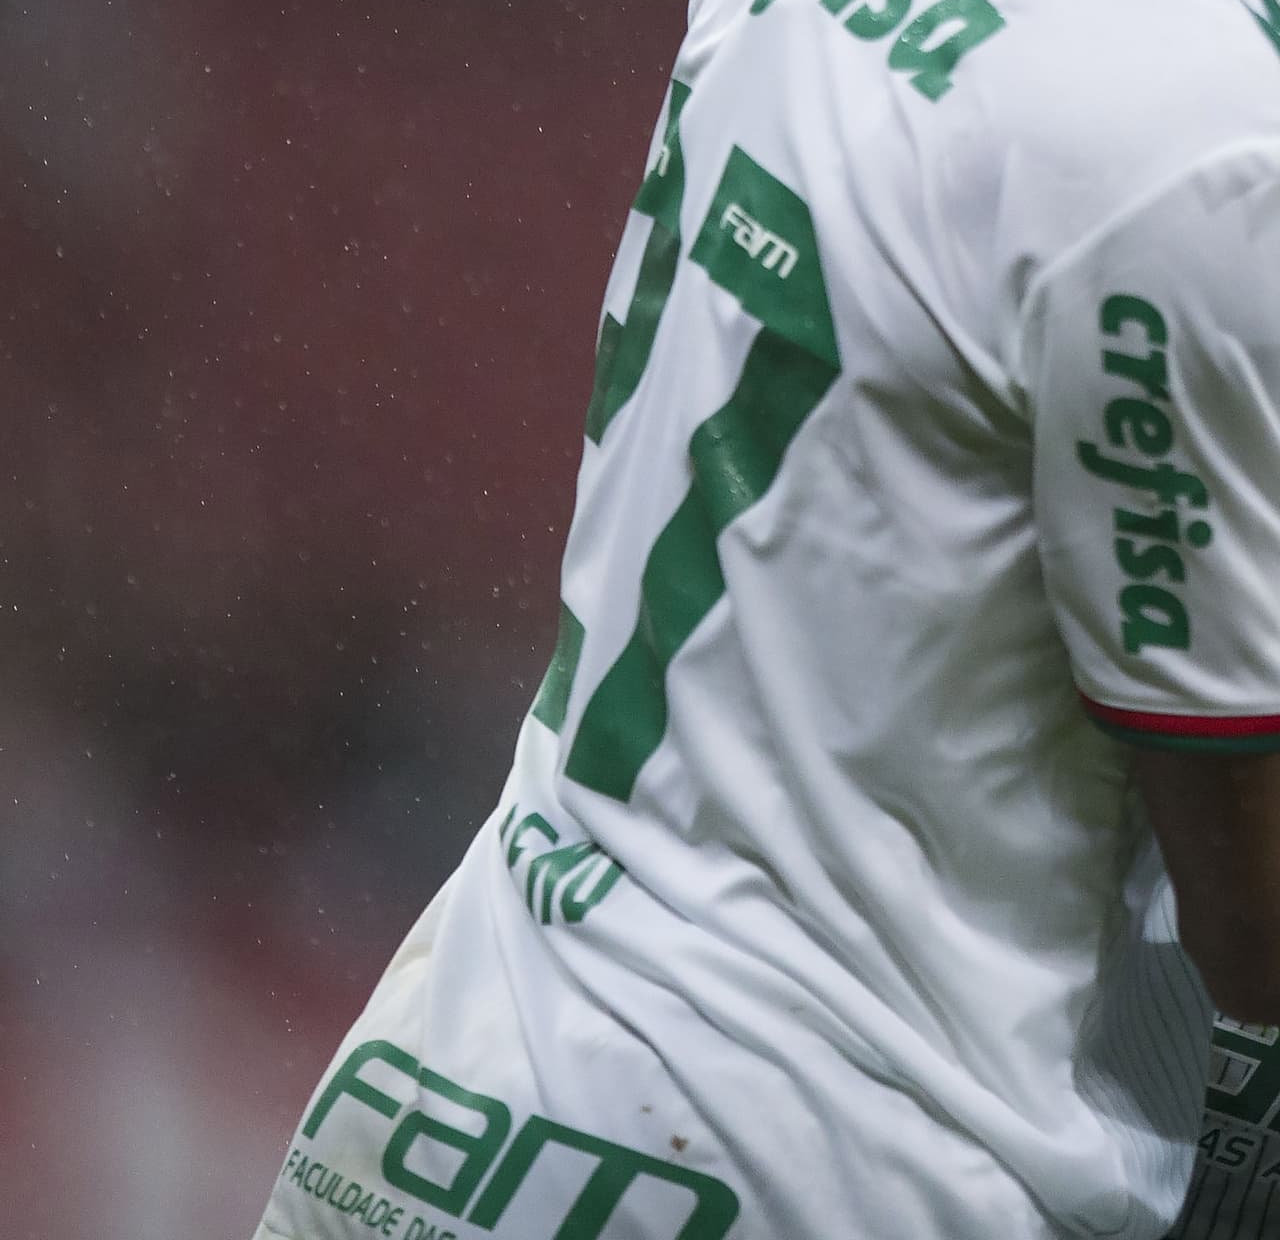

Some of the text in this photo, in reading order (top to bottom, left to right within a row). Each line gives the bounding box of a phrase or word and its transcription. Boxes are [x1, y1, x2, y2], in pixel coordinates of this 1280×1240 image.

[1076, 293, 1214, 656] crefisa
[1199, 1128, 1255, 1167] AS
[282, 1149, 405, 1237] FACULDADE
